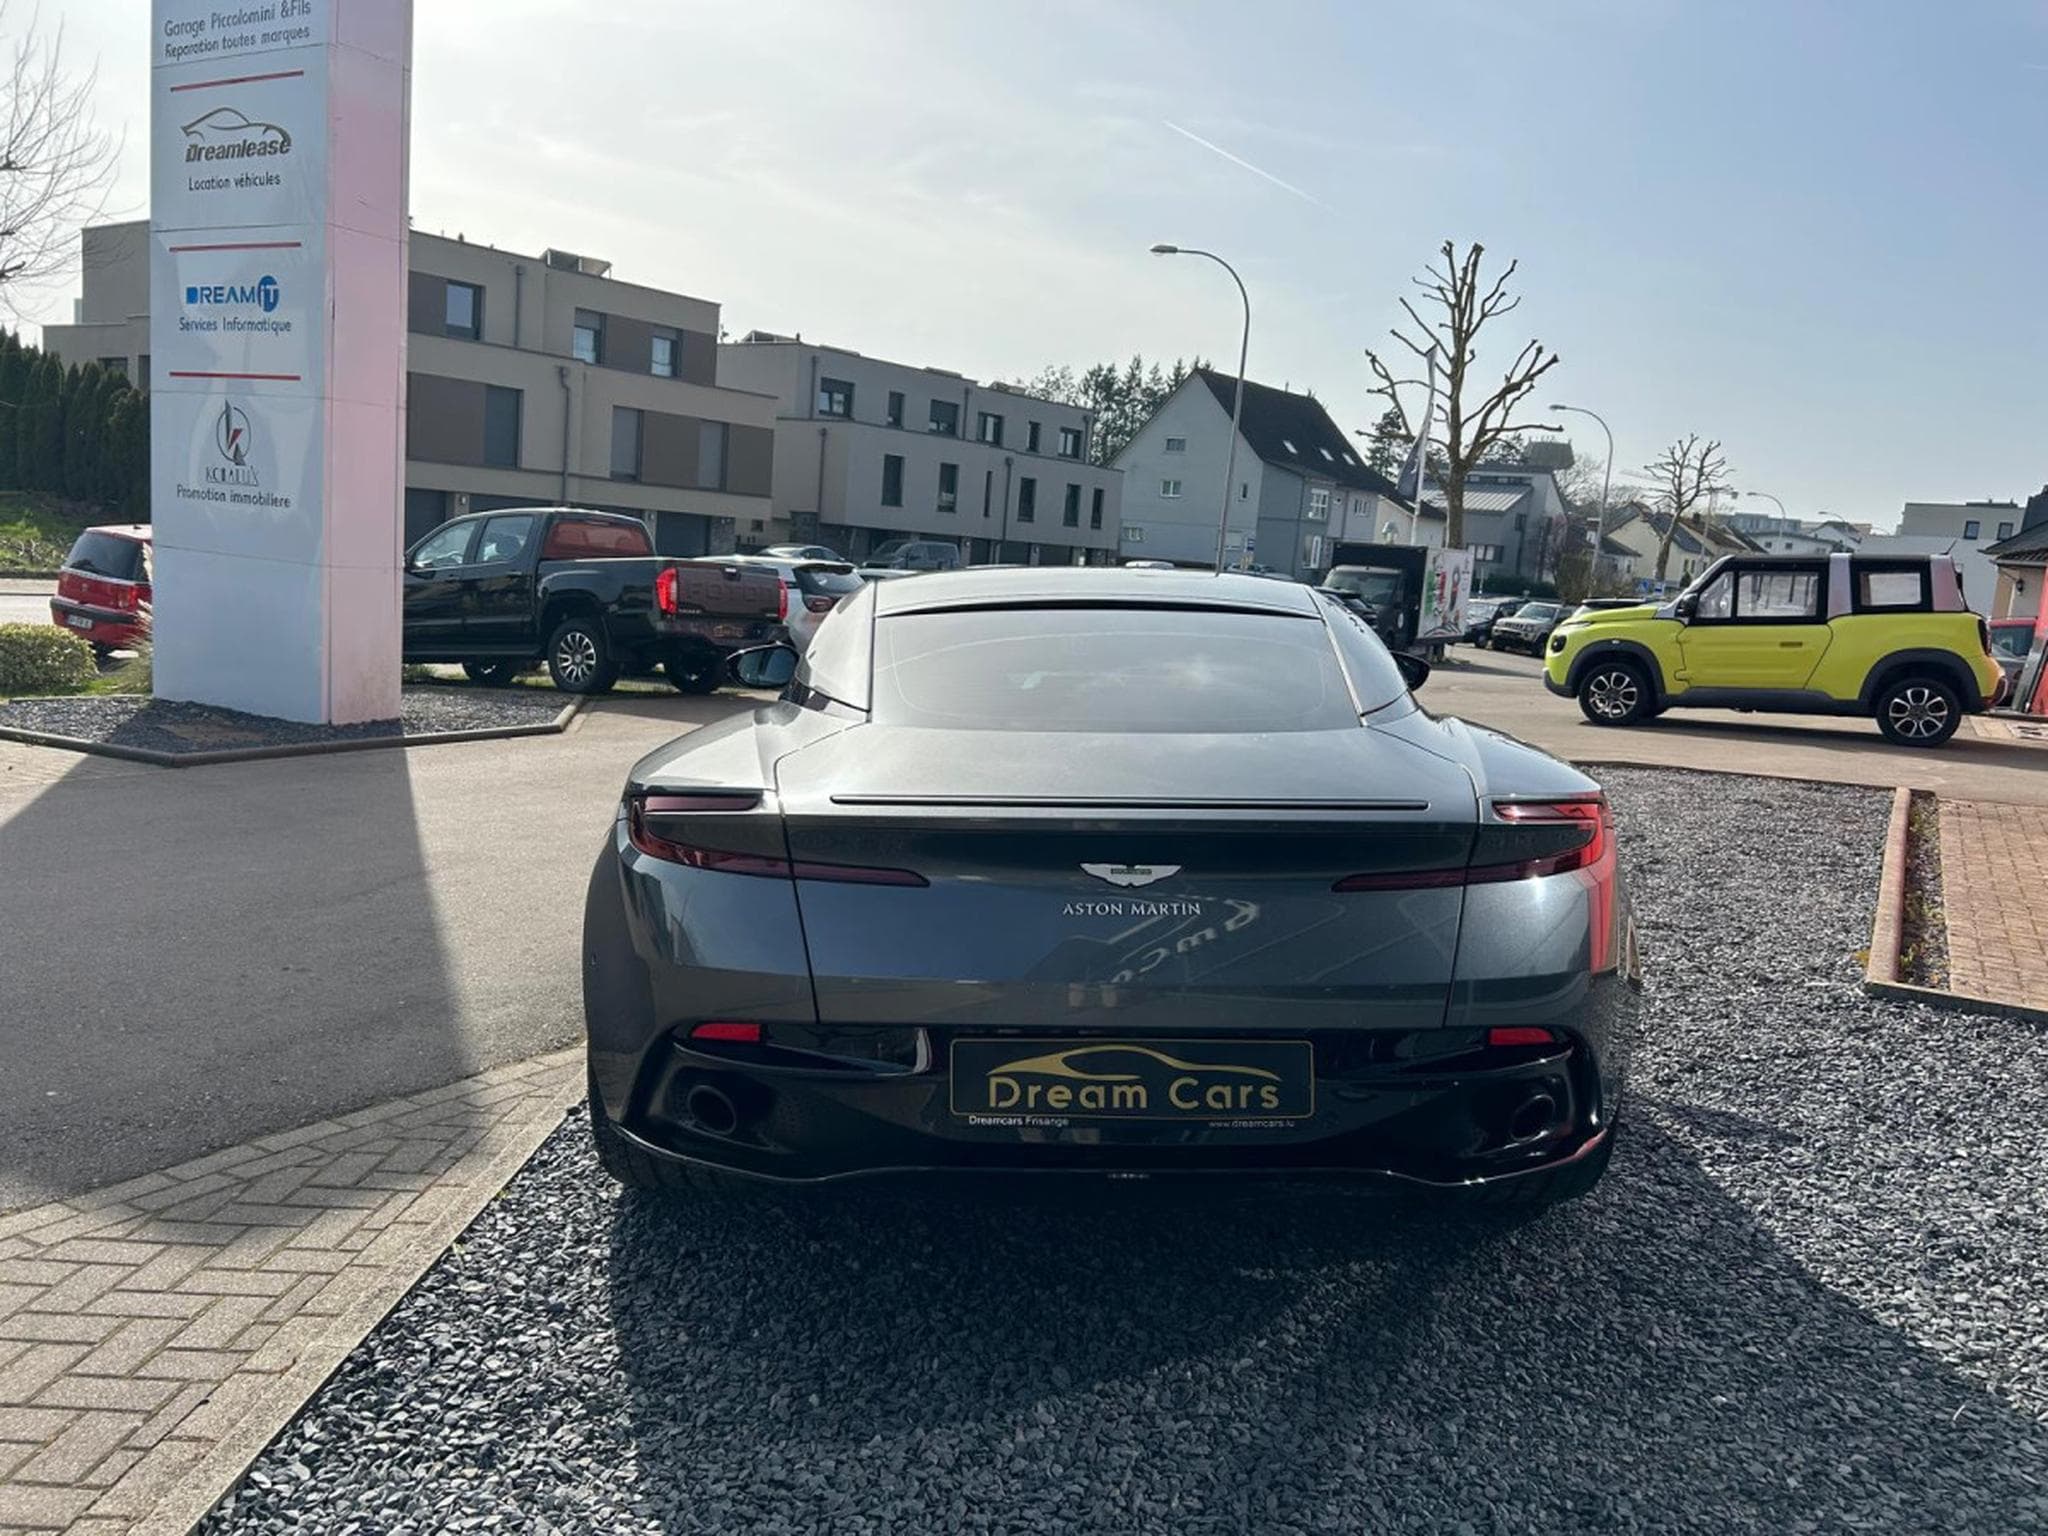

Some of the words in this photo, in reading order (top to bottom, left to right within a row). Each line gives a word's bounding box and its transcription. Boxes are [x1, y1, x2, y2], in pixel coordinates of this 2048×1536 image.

[164, 20, 205, 38] Garage
[211, 5, 275, 30] Piccolomini
[222, 33, 256, 50] toutes
[261, 26, 311, 45] marques
[185, 137, 292, 163] Dreamlease
[188, 177, 230, 191] Location
[178, 317, 217, 332] Services
[223, 316, 292, 336] Informatique
[176, 484, 226, 503] Promotion
[1063, 902, 1123, 916] ASTON
[1130, 902, 1201, 916] MARTIN
[989, 1077, 1148, 1109] Dream
[1168, 1077, 1281, 1109] Cars
[968, 1115, 1023, 1126] Dreamcars
